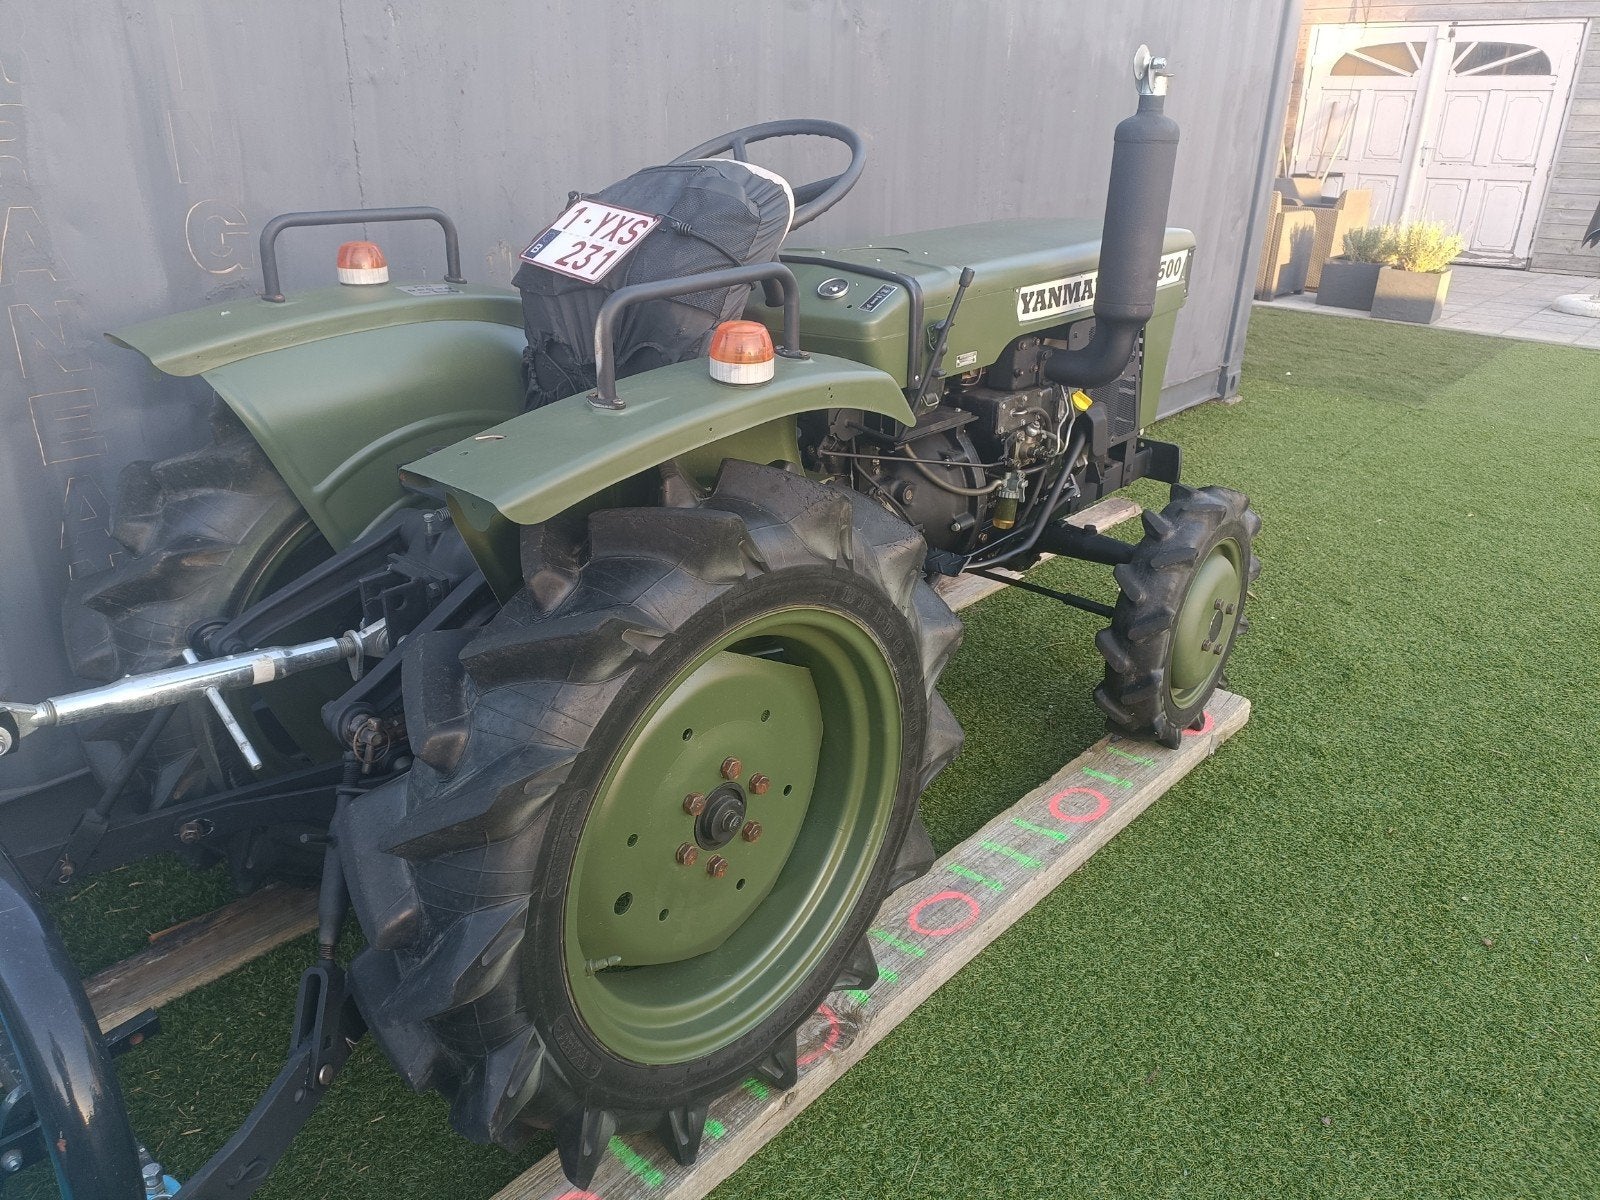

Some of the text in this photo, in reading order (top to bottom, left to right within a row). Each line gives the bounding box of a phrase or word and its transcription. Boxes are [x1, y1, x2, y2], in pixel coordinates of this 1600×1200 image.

[563, 207, 649, 245] 1-YXS
[530, 243, 544, 254] B
[554, 241, 617, 275] 231
[1020, 278, 1094, 315] YANMA
